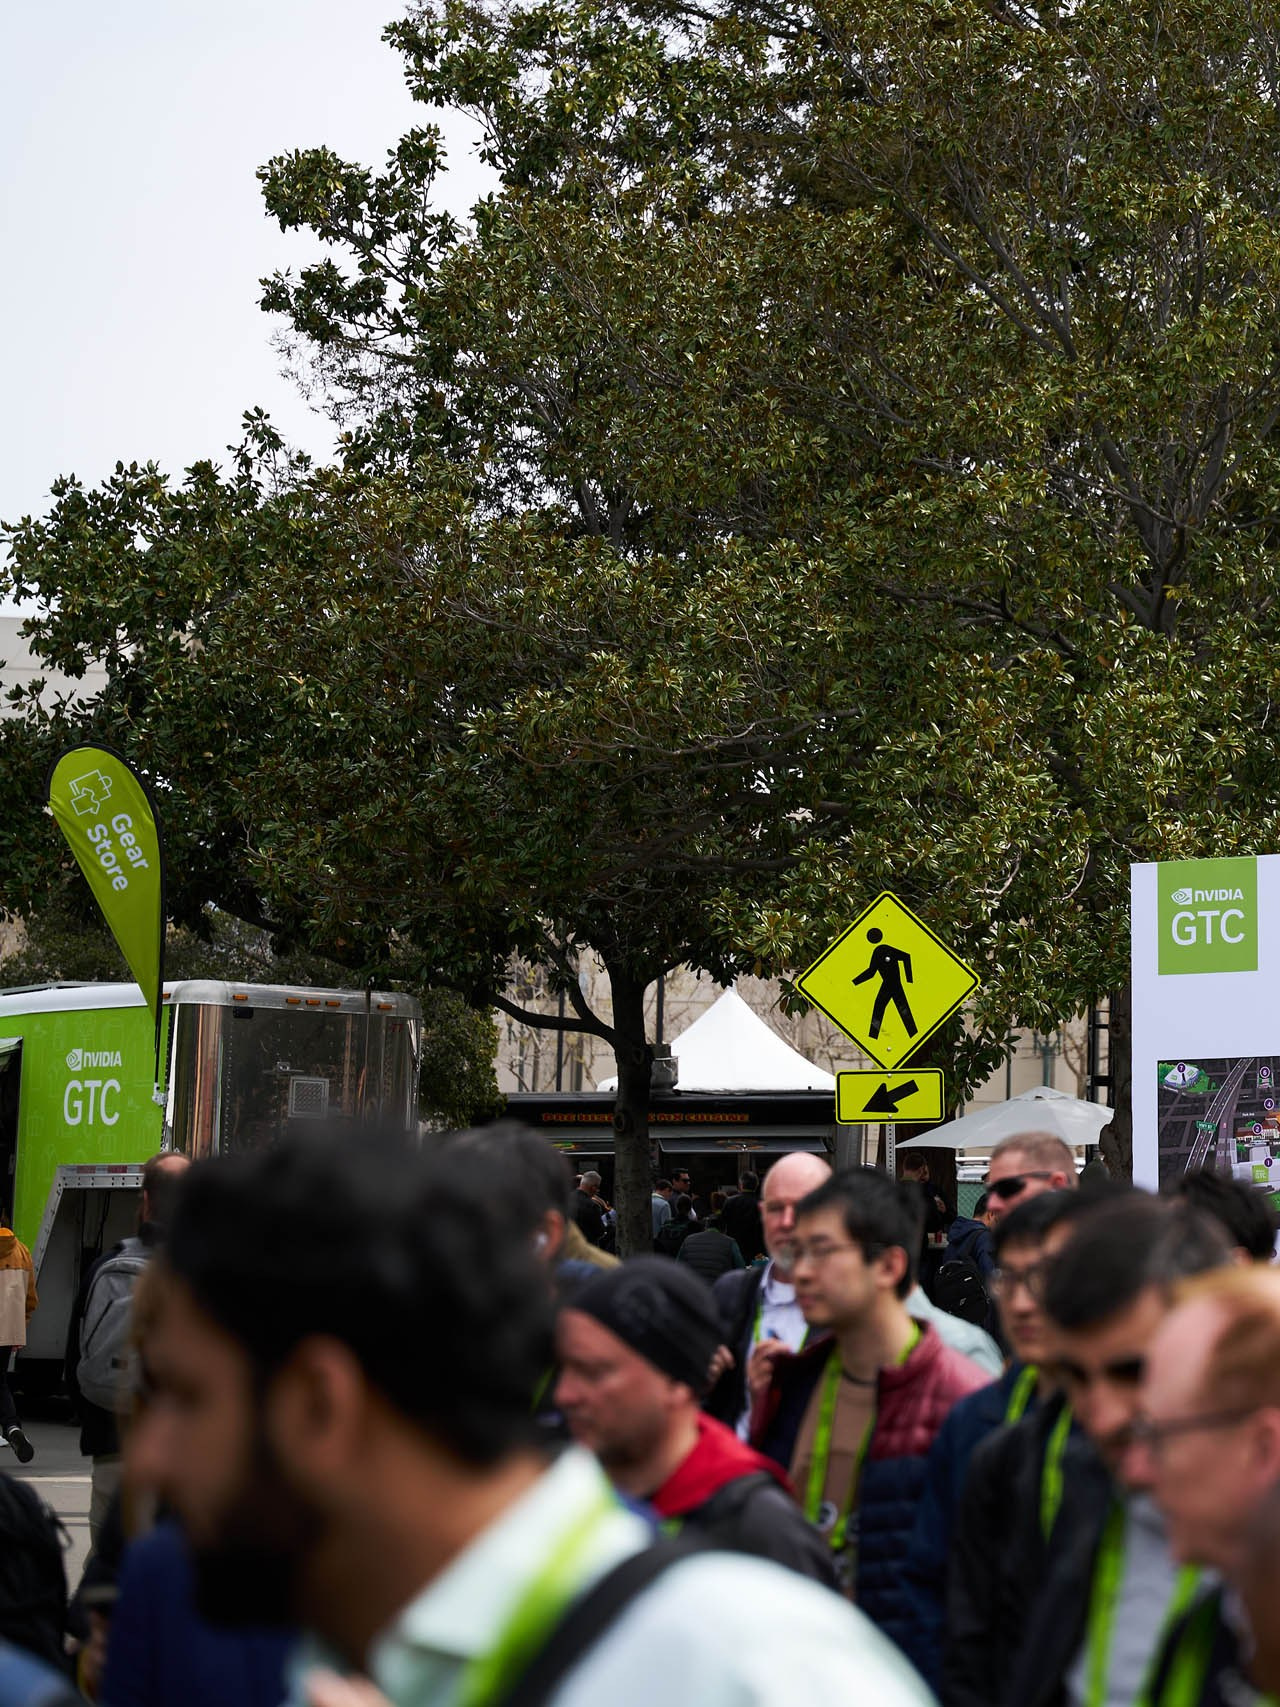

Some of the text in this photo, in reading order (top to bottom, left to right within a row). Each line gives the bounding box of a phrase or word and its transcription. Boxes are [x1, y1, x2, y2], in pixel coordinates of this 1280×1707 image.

[87, 823, 129, 891] Store
[111, 813, 149, 869] Gear
[1194, 887, 1244, 902] NVIDIA
[1171, 908, 1246, 946] GTC
[83, 1050, 122, 1068] NVIDIA
[63, 1078, 121, 1126] GTC
